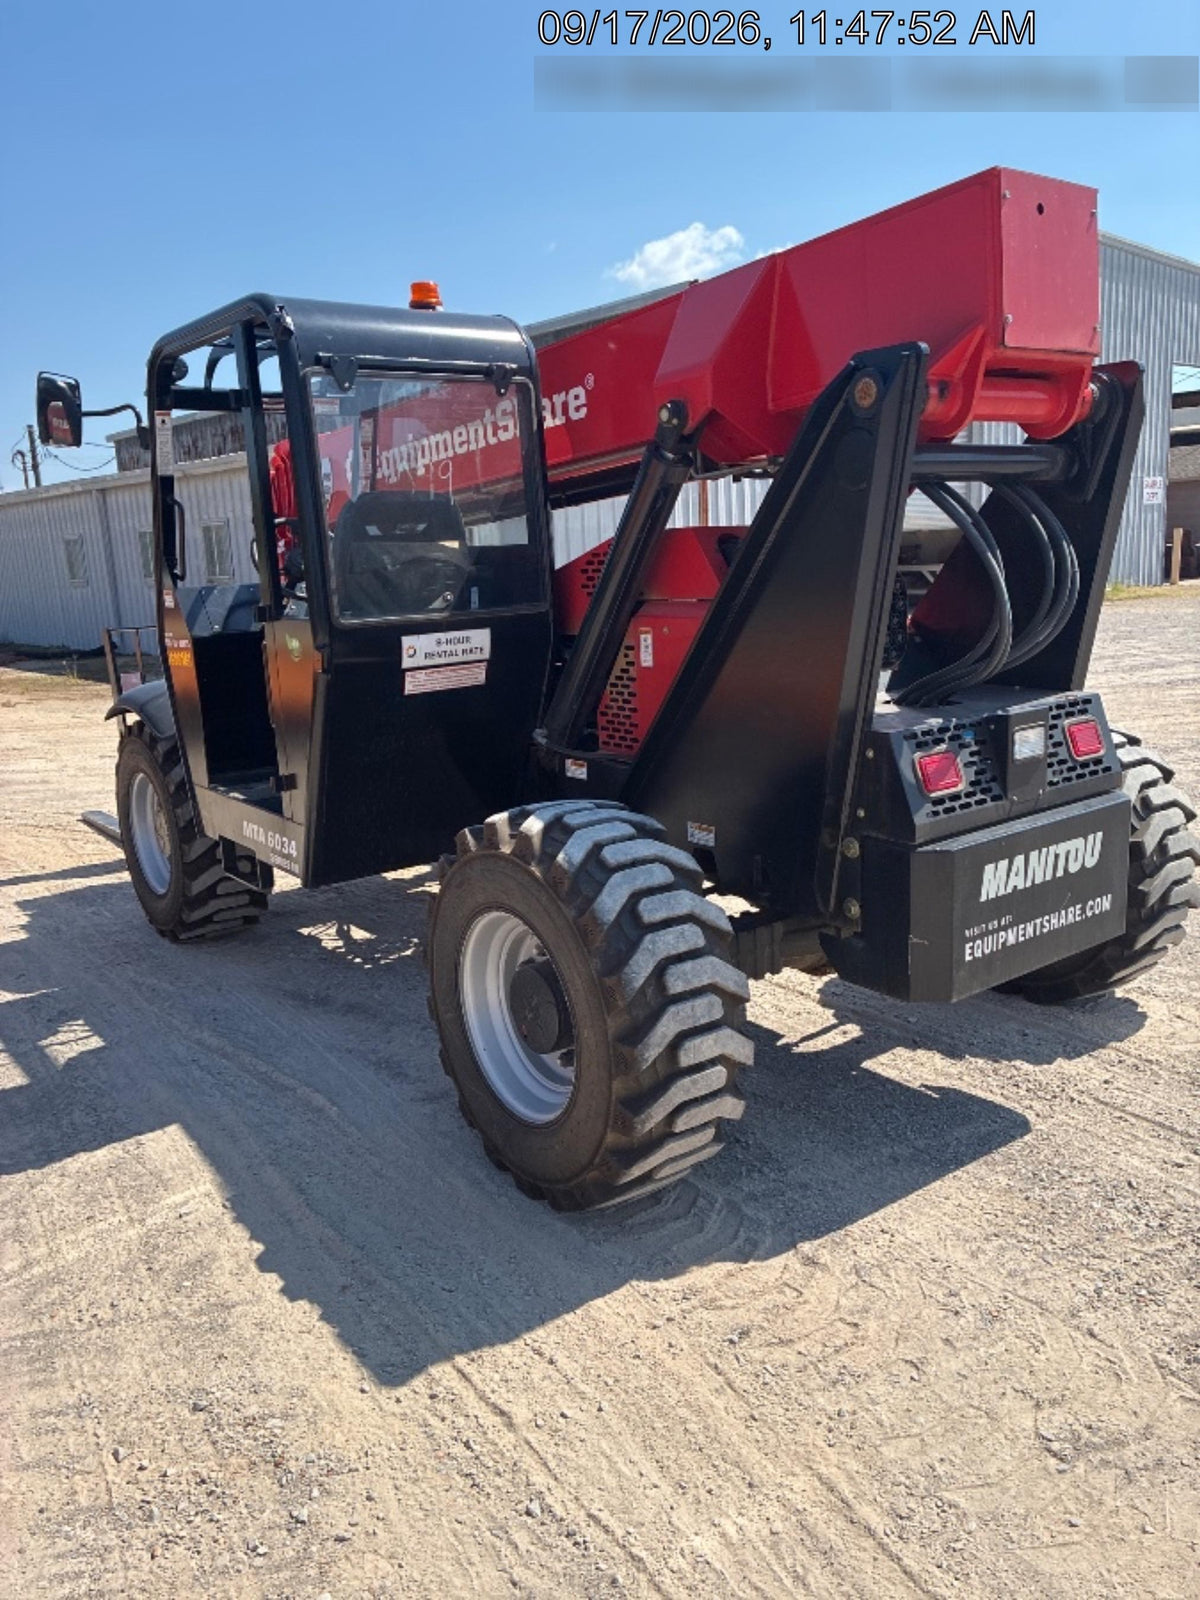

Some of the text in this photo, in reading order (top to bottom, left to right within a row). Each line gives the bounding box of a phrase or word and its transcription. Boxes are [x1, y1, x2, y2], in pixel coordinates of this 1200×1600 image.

[424, 646, 485, 660] RENTAL RATE
[242, 820, 298, 858] MTA 6034
[979, 831, 1104, 902] MANITOU
